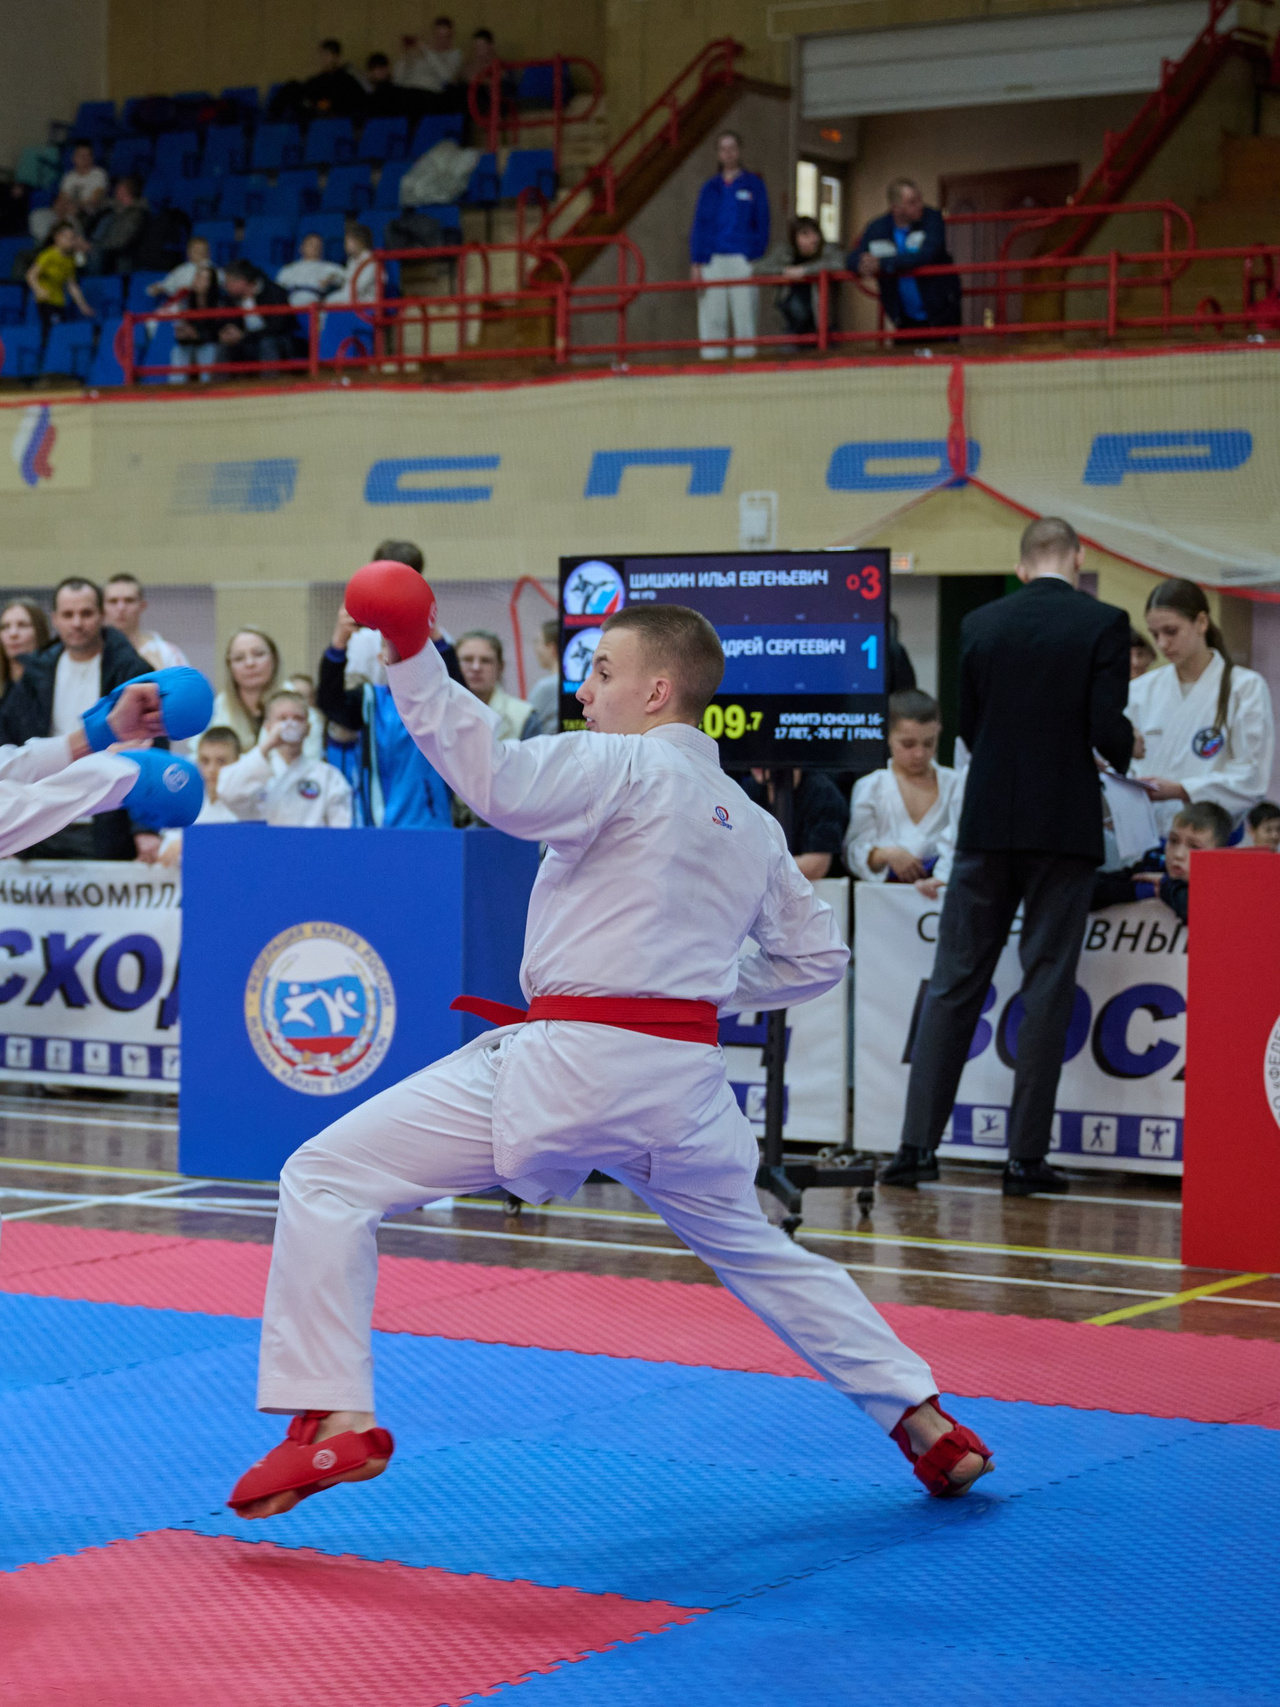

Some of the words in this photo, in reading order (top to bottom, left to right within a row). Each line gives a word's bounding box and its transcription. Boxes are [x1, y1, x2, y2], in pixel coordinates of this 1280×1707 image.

[629, 574, 695, 589] ШИШКИН
[698, 572, 736, 587] ИЛЬЯ
[739, 570, 829, 587] ЕВГЕНЬЕВИЧ
[766, 638, 846, 655] СЕРГЕЕВИЧ
[861, 635, 877, 669] 1
[65, 882, 182, 909] КОМПЛ
